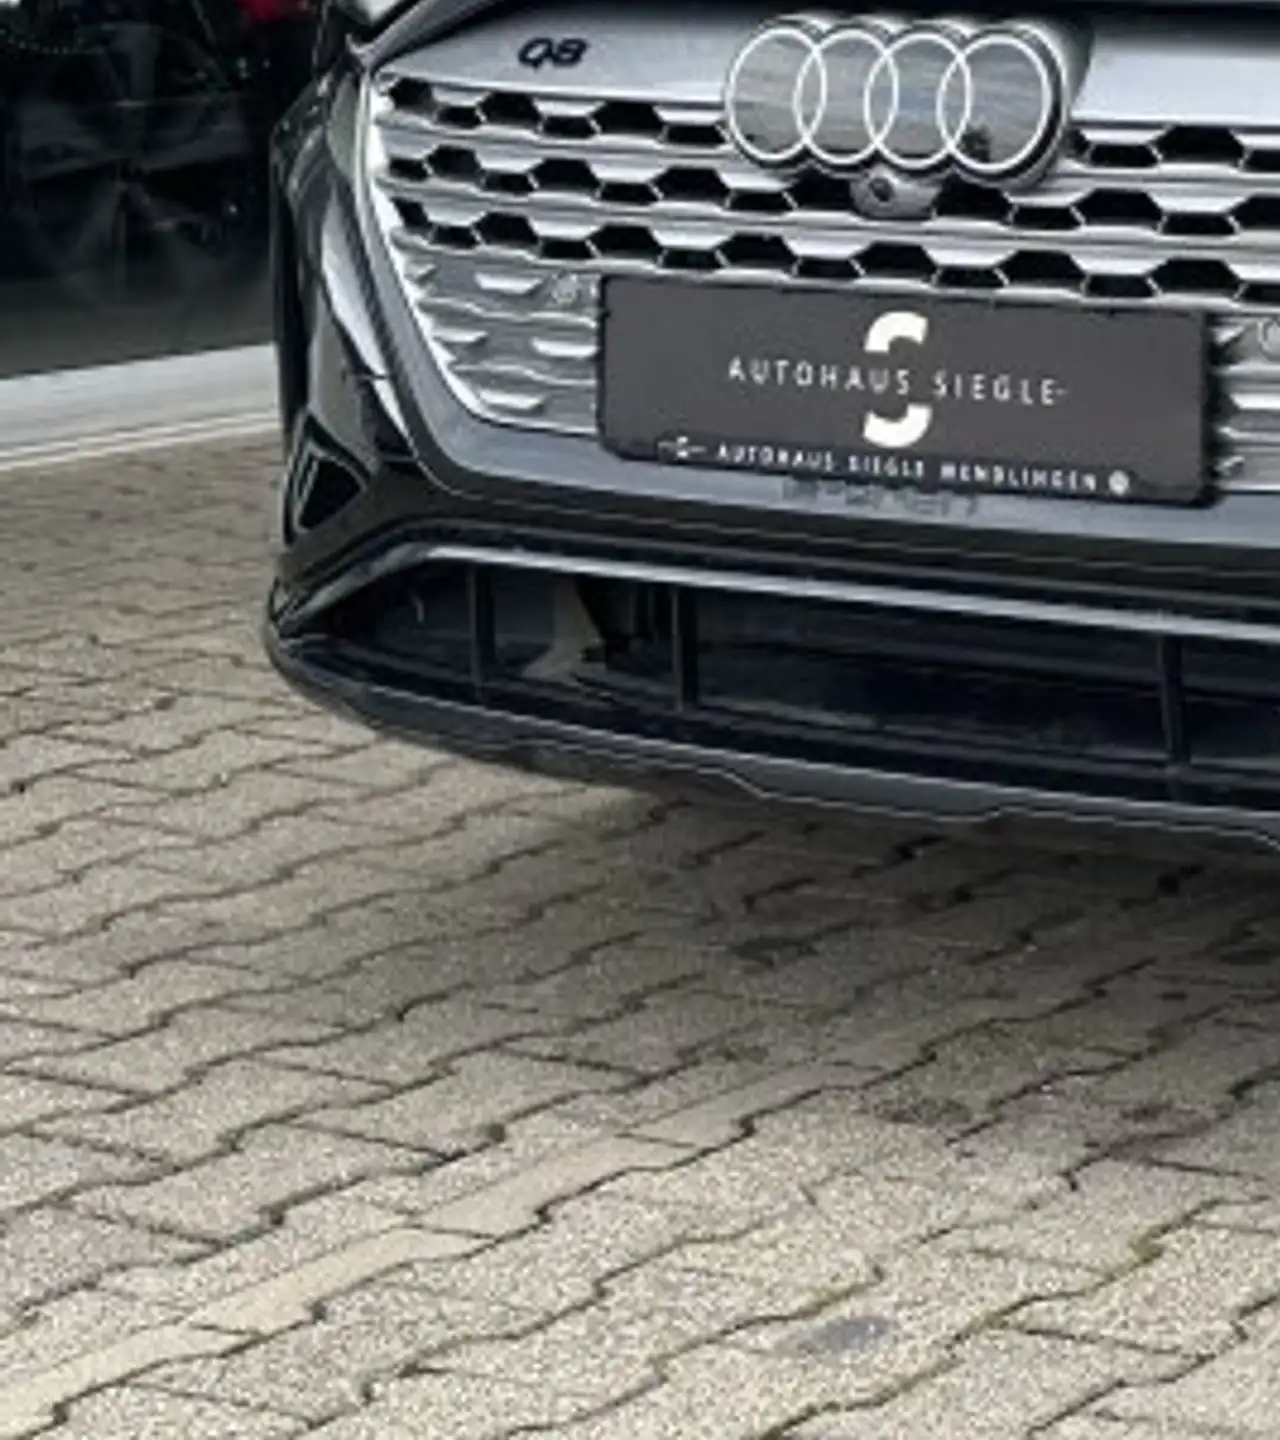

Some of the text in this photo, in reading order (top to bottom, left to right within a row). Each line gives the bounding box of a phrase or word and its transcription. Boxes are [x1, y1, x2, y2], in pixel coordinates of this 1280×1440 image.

[517, 36, 588, 72] Q8
[728, 356, 1057, 406] AUTOHAUS SIEGLE
[717, 442, 834, 472] AUTOHAUS
